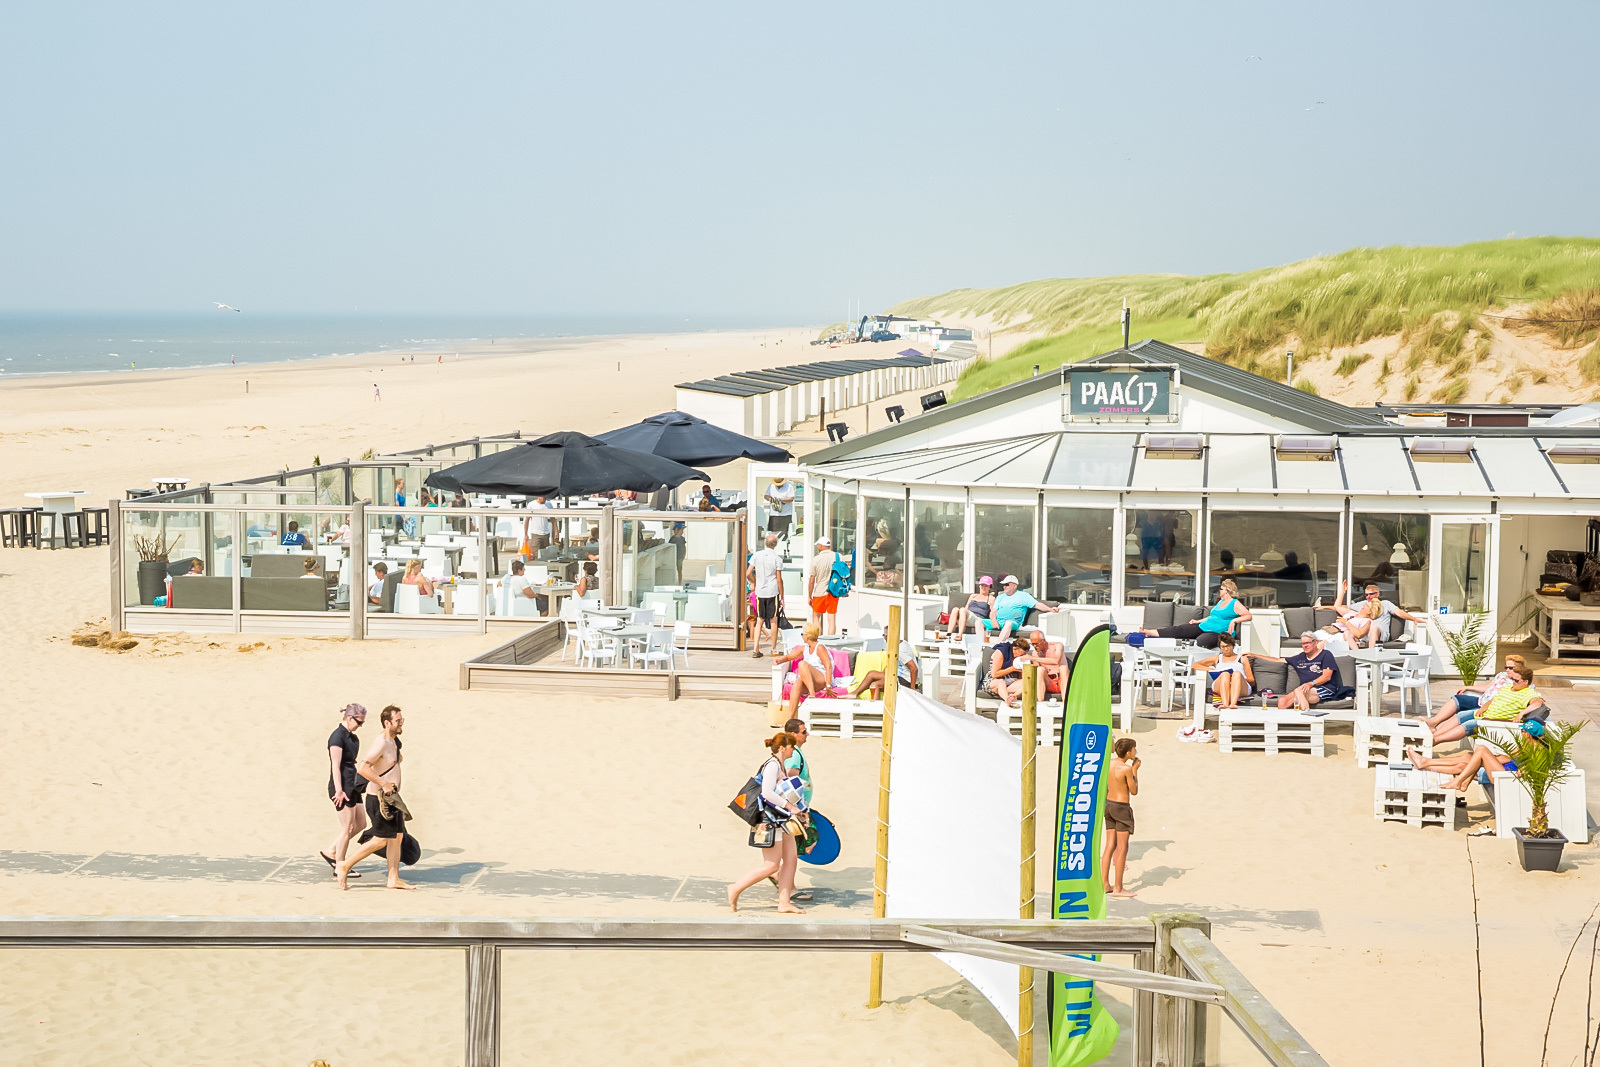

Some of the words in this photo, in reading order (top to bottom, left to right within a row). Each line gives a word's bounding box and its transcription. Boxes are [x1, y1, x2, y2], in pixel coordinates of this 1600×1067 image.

[1060, 785, 1078, 870] SUPPORTER
[1072, 752, 1083, 781] VAN
[1067, 752, 1101, 871] SCHOON
